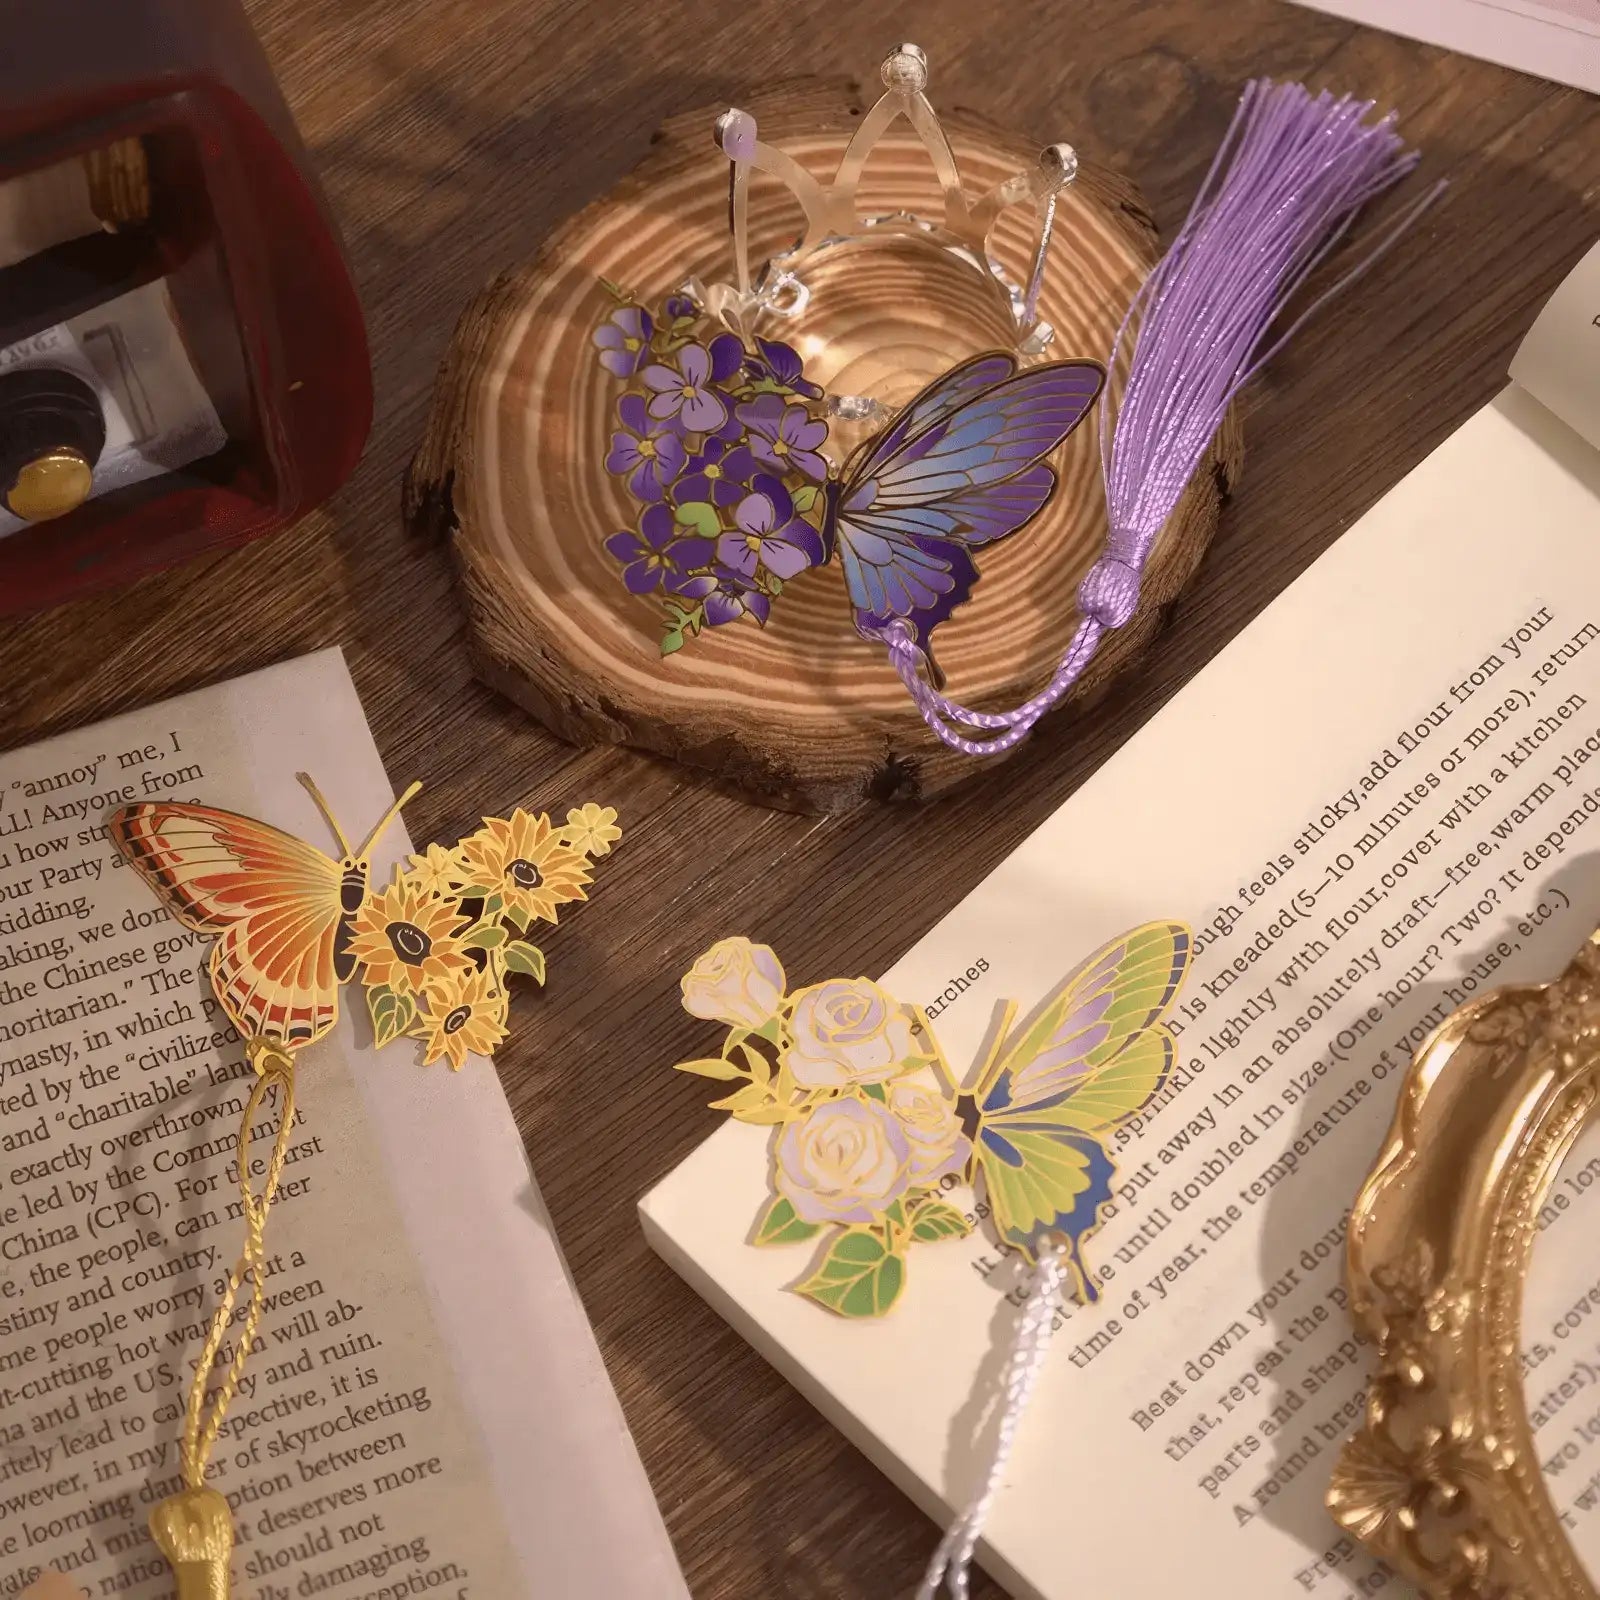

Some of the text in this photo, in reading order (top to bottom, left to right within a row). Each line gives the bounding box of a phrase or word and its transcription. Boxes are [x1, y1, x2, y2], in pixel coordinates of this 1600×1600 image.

[117, 745, 164, 769] me,
[169, 731, 181, 752] I
[1239, 854, 1295, 906] feels
[1294, 749, 1403, 855] sticky,add
[1397, 701, 1454, 754] flour
[1449, 655, 1506, 704] from
[1501, 607, 1554, 659] your
[42, 786, 138, 824] Anyone
[141, 764, 205, 795] from
[1180, 997, 1207, 1022] is
[1353, 773, 1440, 856] minutes
[1440, 748, 1466, 772] or
[1463, 689, 1536, 751] more),
[1531, 623, 1600, 686] return
[14, 836, 69, 863] how
[39, 858, 102, 889] Party
[1200, 987, 1276, 1059] lightly
[1275, 941, 1330, 987] with
[1325, 829, 1442, 941] flour,cover
[1438, 784, 1492, 829] with
[1491, 768, 1509, 783] a
[1501, 694, 1587, 769] kitchen
[1498, 869, 1524, 892] It
[78, 923, 116, 943] we
[1440, 888, 1502, 948] hour?
[1440, 888, 1502, 960] Two?
[0, 982, 38, 1006] the
[43, 948, 147, 989] Chinese
[141, 969, 194, 996] The
[83, 1030, 112, 1052] in
[115, 1002, 196, 1040] which
[1281, 1007, 1383, 1105] size.(One
[0, 1084, 39, 1116] ted
[41, 1079, 72, 1103] by
[79, 1065, 120, 1089] the
[1117, 1162, 1159, 1207] put
[1157, 1106, 1216, 1165] away
[1212, 1084, 1244, 1109] in
[1242, 1055, 1274, 1084] an
[1272, 947, 1381, 1055] absolutely
[2, 1117, 51, 1152] and
[10, 1143, 92, 1185] exactly
[101, 1098, 246, 1156] overthrown
[1068, 1320, 1123, 1368] time
[1123, 1290, 1150, 1319] of
[1146, 1243, 1207, 1300] year,
[1201, 1204, 1242, 1242] the
[1239, 1080, 1372, 1205] temperature
[1372, 1050, 1398, 1079] of
[1394, 1003, 1448, 1060] your
[1442, 942, 1521, 1007] house,
[1516, 889, 1570, 936] etc.)
[1253, 1104, 1285, 1131] in
[21, 1186, 64, 1219] led
[66, 1180, 98, 1205] by
[106, 1165, 147, 1190] the
[1170, 1124, 1260, 1212] doubled
[2, 1225, 80, 1260] China
[87, 1192, 170, 1239] (CPC).
[174, 1175, 218, 1202] For
[30, 1263, 72, 1287] the
[76, 1229, 168, 1279] people,
[175, 1211, 221, 1237] can
[1113, 1208, 1172, 1264] until
[43, 1312, 128, 1363] people
[133, 1284, 204, 1322] worry
[290, 1251, 306, 1268] a
[66, 1276, 116, 1312] and
[122, 1245, 222, 1292] country.
[31, 1396, 80, 1433] and
[86, 1386, 127, 1412] the
[271, 1310, 320, 1344] will
[325, 1300, 363, 1327] ab-
[114, 1336, 160, 1365] hot
[1129, 1380, 1187, 1432] Beat
[1184, 1321, 1251, 1382] down
[1246, 1268, 1300, 1326] your
[1164, 1305, 1328, 1461] that, repeat the
[58, 1420, 115, 1458] lead
[120, 1416, 145, 1435] to
[265, 1348, 314, 1385] and
[319, 1333, 382, 1365] ruin.
[93, 1460, 122, 1483] in
[127, 1442, 166, 1471] my
[330, 1376, 352, 1397] it
[355, 1367, 378, 1389] is
[22, 1494, 134, 1547] looming
[139, 1458, 227, 1503] daner
[235, 1440, 261, 1468] of
[267, 1387, 431, 1458] skyrocketing
[296, 1432, 406, 1482] between
[1198, 1435, 1260, 1499] parts
[1259, 1390, 1304, 1435] and
[258, 1483, 367, 1535] deserves
[373, 1457, 442, 1495] more
[1233, 1504, 1255, 1528] A
[1251, 1436, 1322, 1506] round
[245, 1528, 334, 1579] should
[339, 1514, 385, 1544] not
[297, 1537, 430, 1597] damaging
